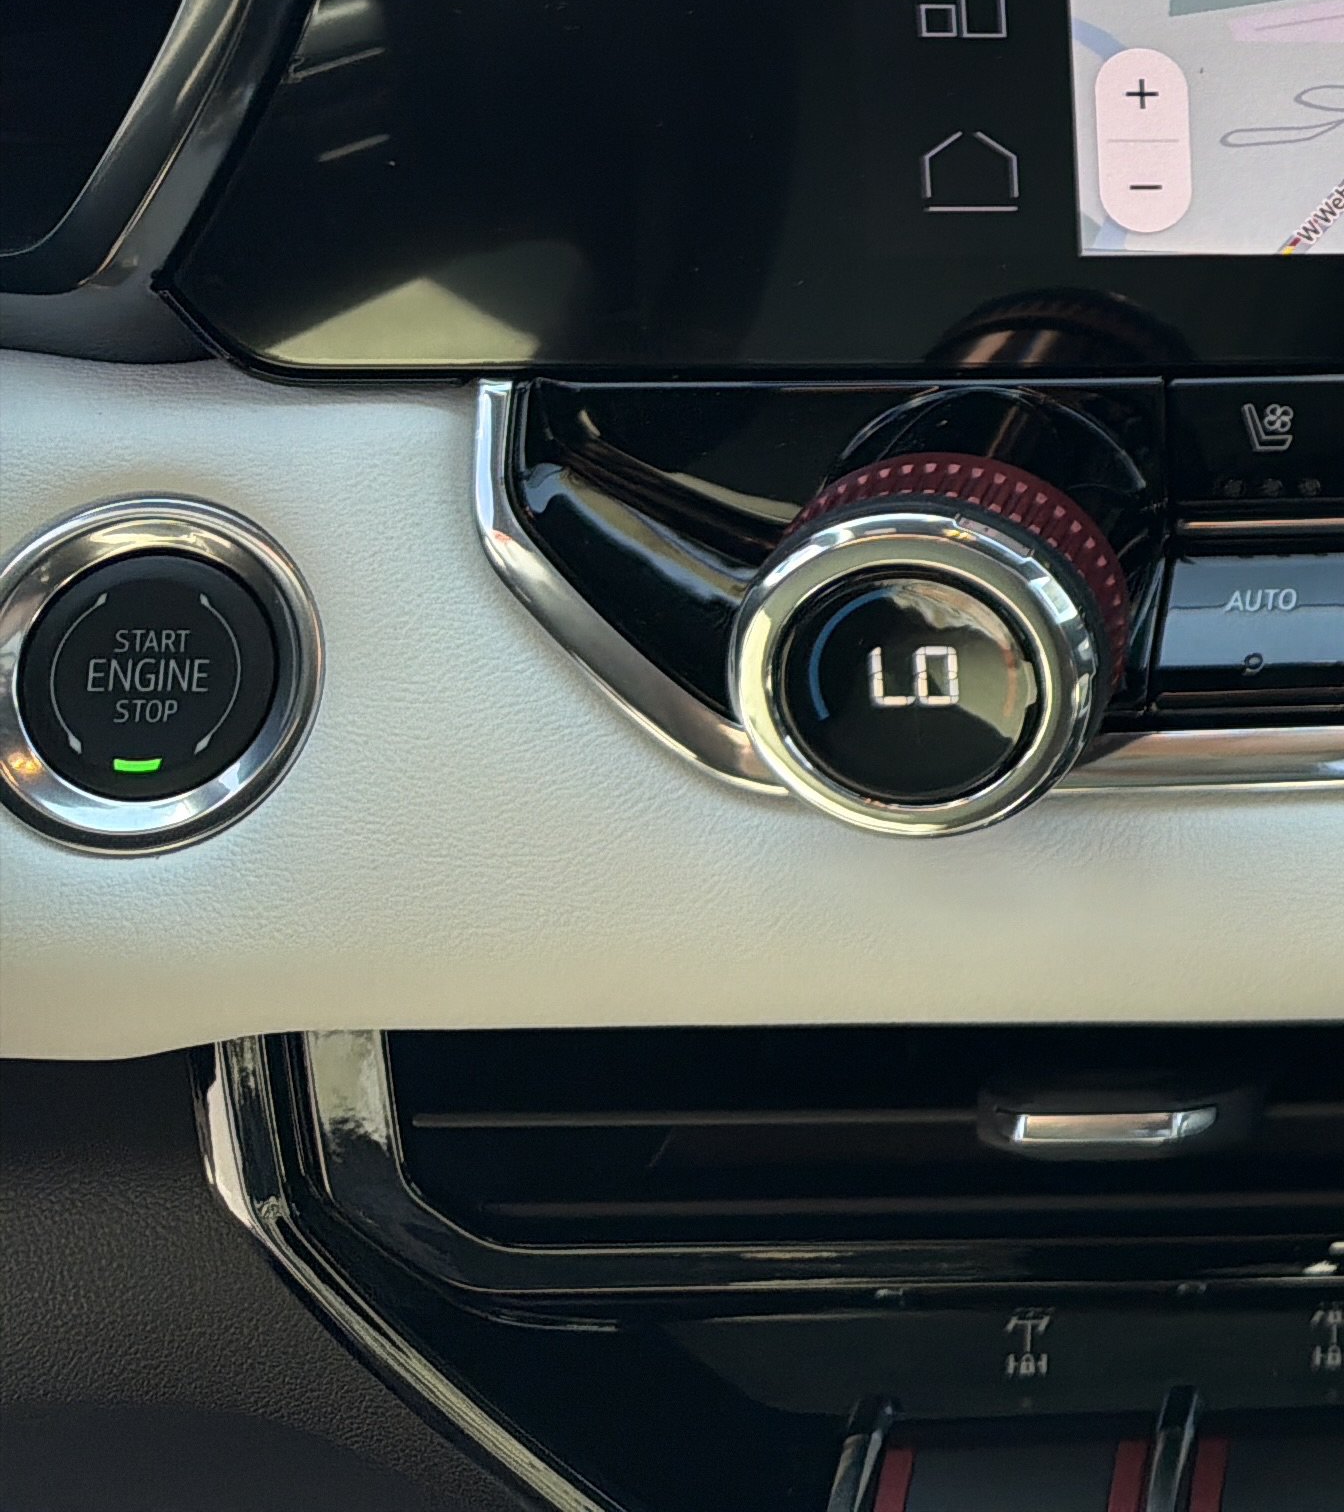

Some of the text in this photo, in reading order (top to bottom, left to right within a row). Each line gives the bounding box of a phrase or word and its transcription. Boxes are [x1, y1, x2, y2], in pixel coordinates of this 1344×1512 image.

[1297, 219, 1321, 242] W
[1225, 587, 1297, 612] AUTO
[114, 629, 190, 653] START
[86, 659, 210, 692] ENGINE
[867, 645, 960, 707] LO
[113, 699, 178, 723] STOP
